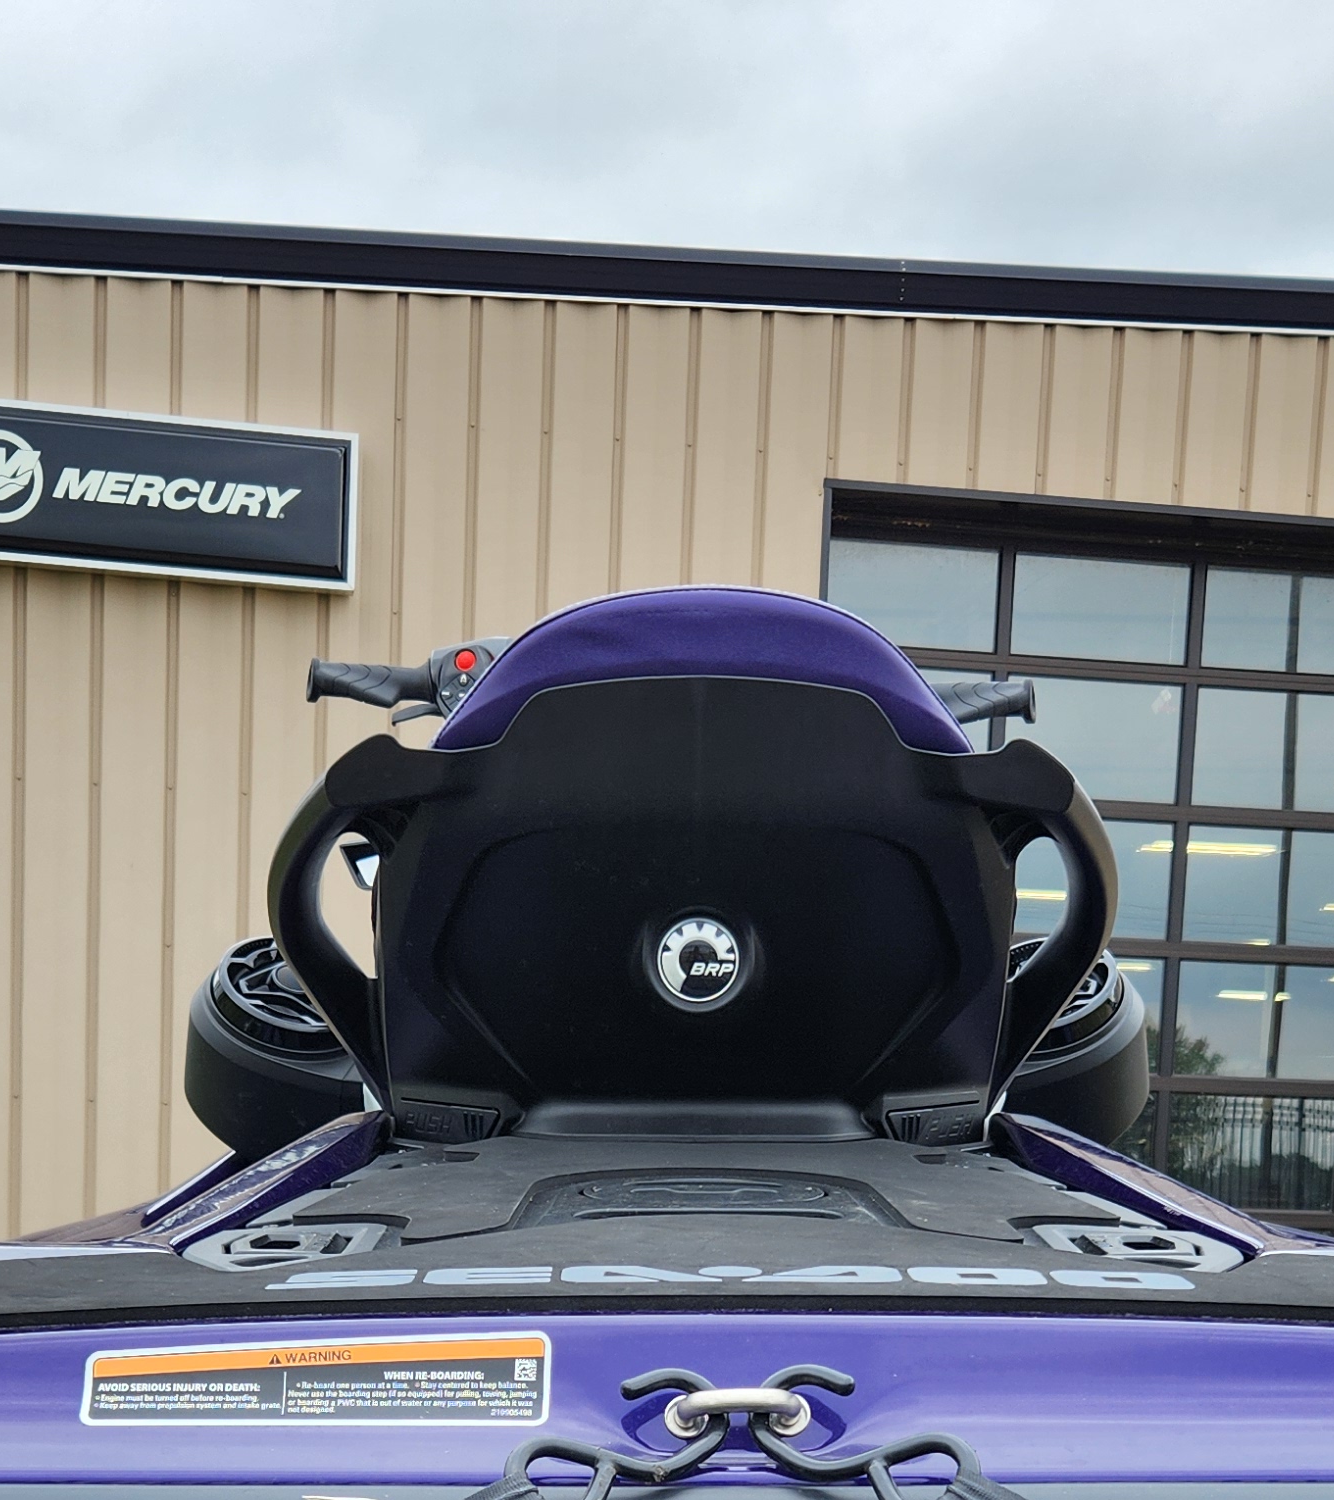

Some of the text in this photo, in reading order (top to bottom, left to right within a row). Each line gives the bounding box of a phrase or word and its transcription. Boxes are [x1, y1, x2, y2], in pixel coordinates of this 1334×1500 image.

[51, 467, 302, 519] MERCURY
[690, 962, 735, 977] BRP
[405, 1111, 453, 1135] PUSH
[284, 1349, 352, 1364] WARNING
[384, 1371, 485, 1381] WHEN RE-BOARDING:
[98, 1383, 129, 1392] AVOID
[130, 1383, 172, 1392] SERIOUS
[173, 1383, 208, 1392] INJURY
[224, 1383, 261, 1392] DEATH:
